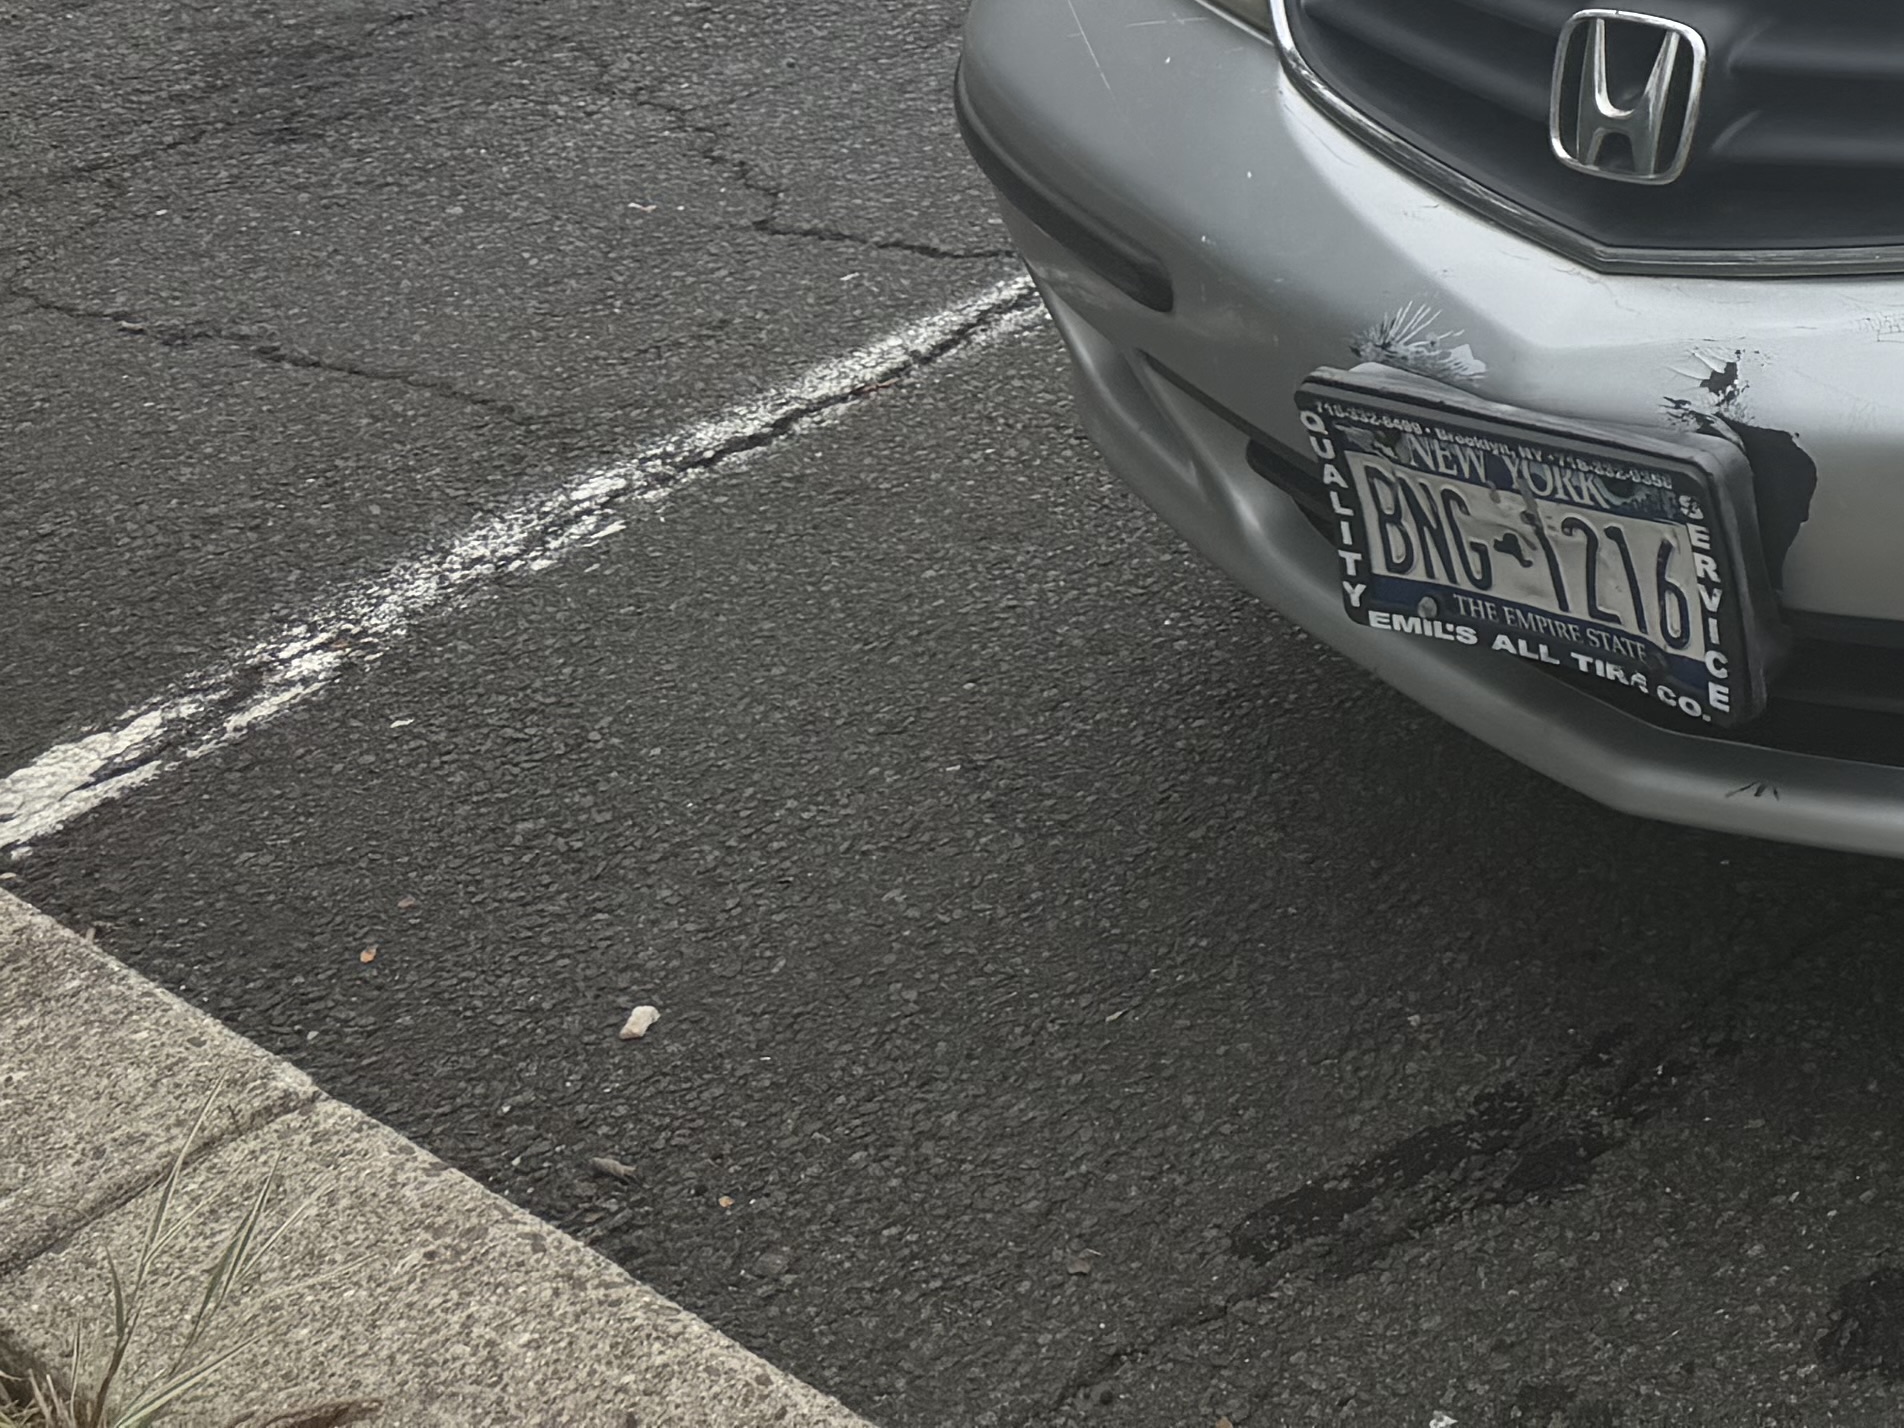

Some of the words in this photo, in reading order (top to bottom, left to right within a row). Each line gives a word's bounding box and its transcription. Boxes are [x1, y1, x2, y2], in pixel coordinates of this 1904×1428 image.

[1402, 431, 1489, 482] NEW
[1500, 449, 1611, 509] YORK
[1518, 445, 1542, 462] NY
[1300, 410, 1367, 608] QUALITY
[1452, 593, 1499, 623] THE
[1505, 607, 1582, 642] EMPIRE
[1585, 629, 1647, 665] STATE
[1678, 494, 1730, 713] SERVICE
[1368, 610, 1479, 646] EMIL'S
[1491, 634, 1561, 666] ALL
[1656, 684, 1712, 722] CO.
